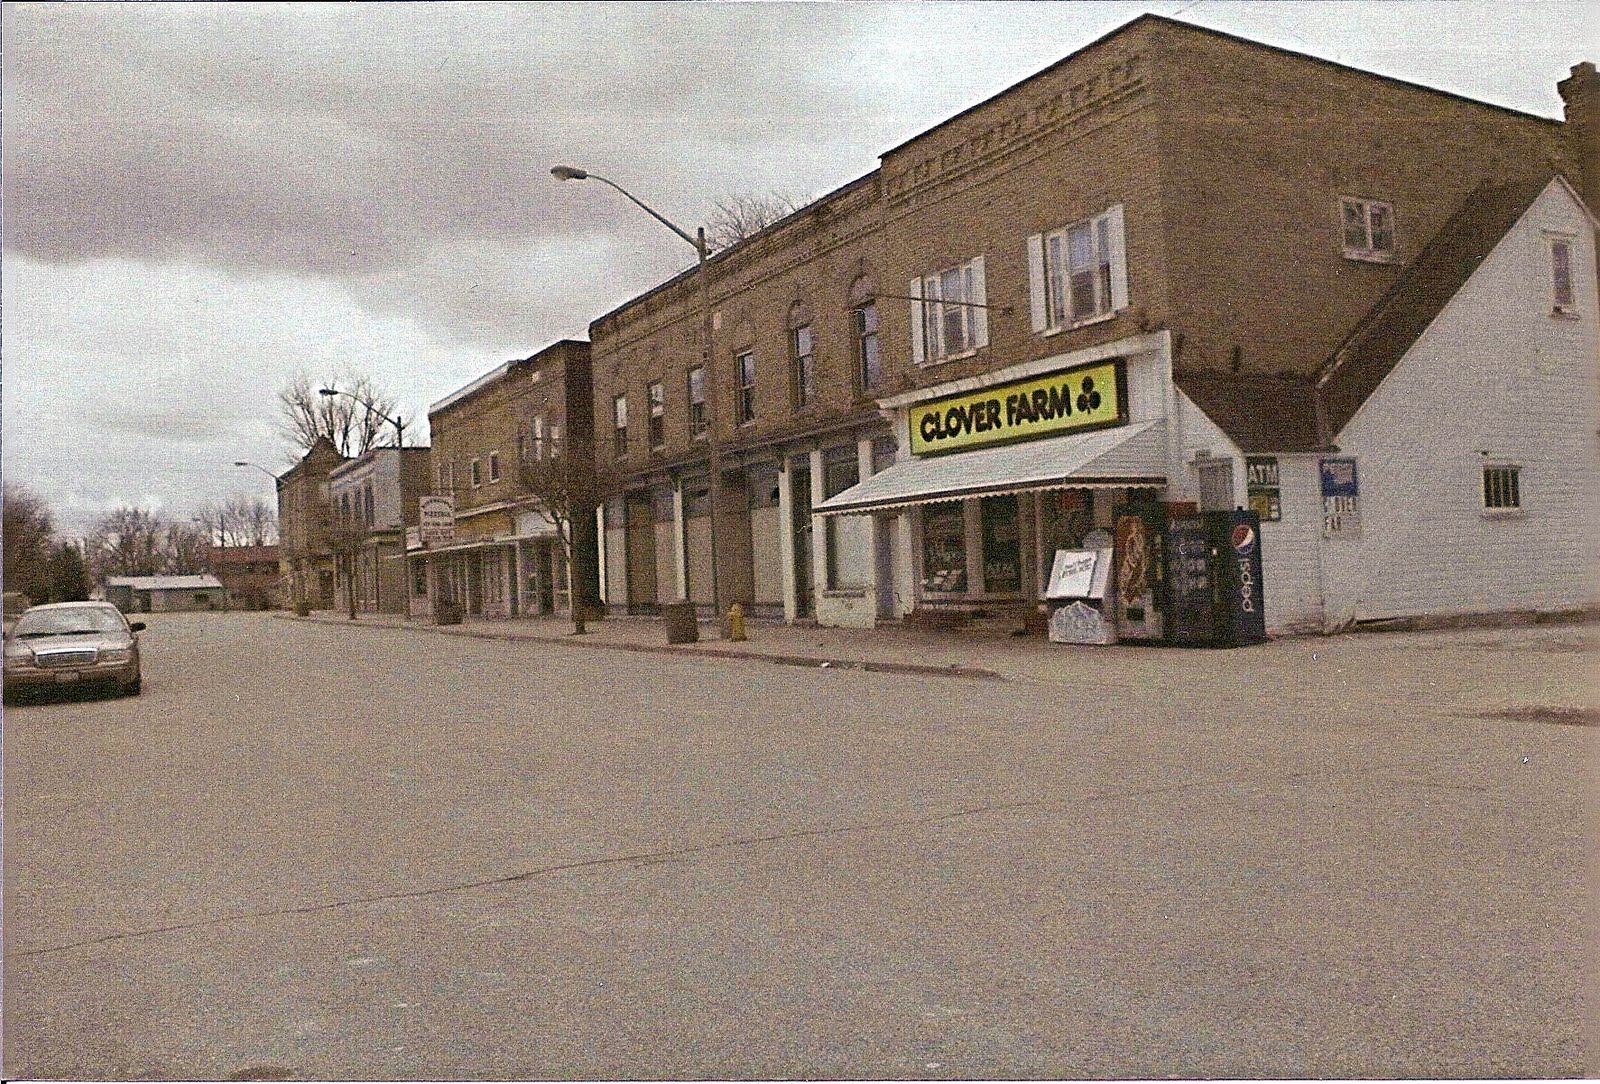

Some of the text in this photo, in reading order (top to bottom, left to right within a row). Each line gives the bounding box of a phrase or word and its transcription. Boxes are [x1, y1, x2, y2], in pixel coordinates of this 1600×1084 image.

[920, 383, 1072, 442] CLOVER FARM
[1248, 463, 1279, 485] ATM
